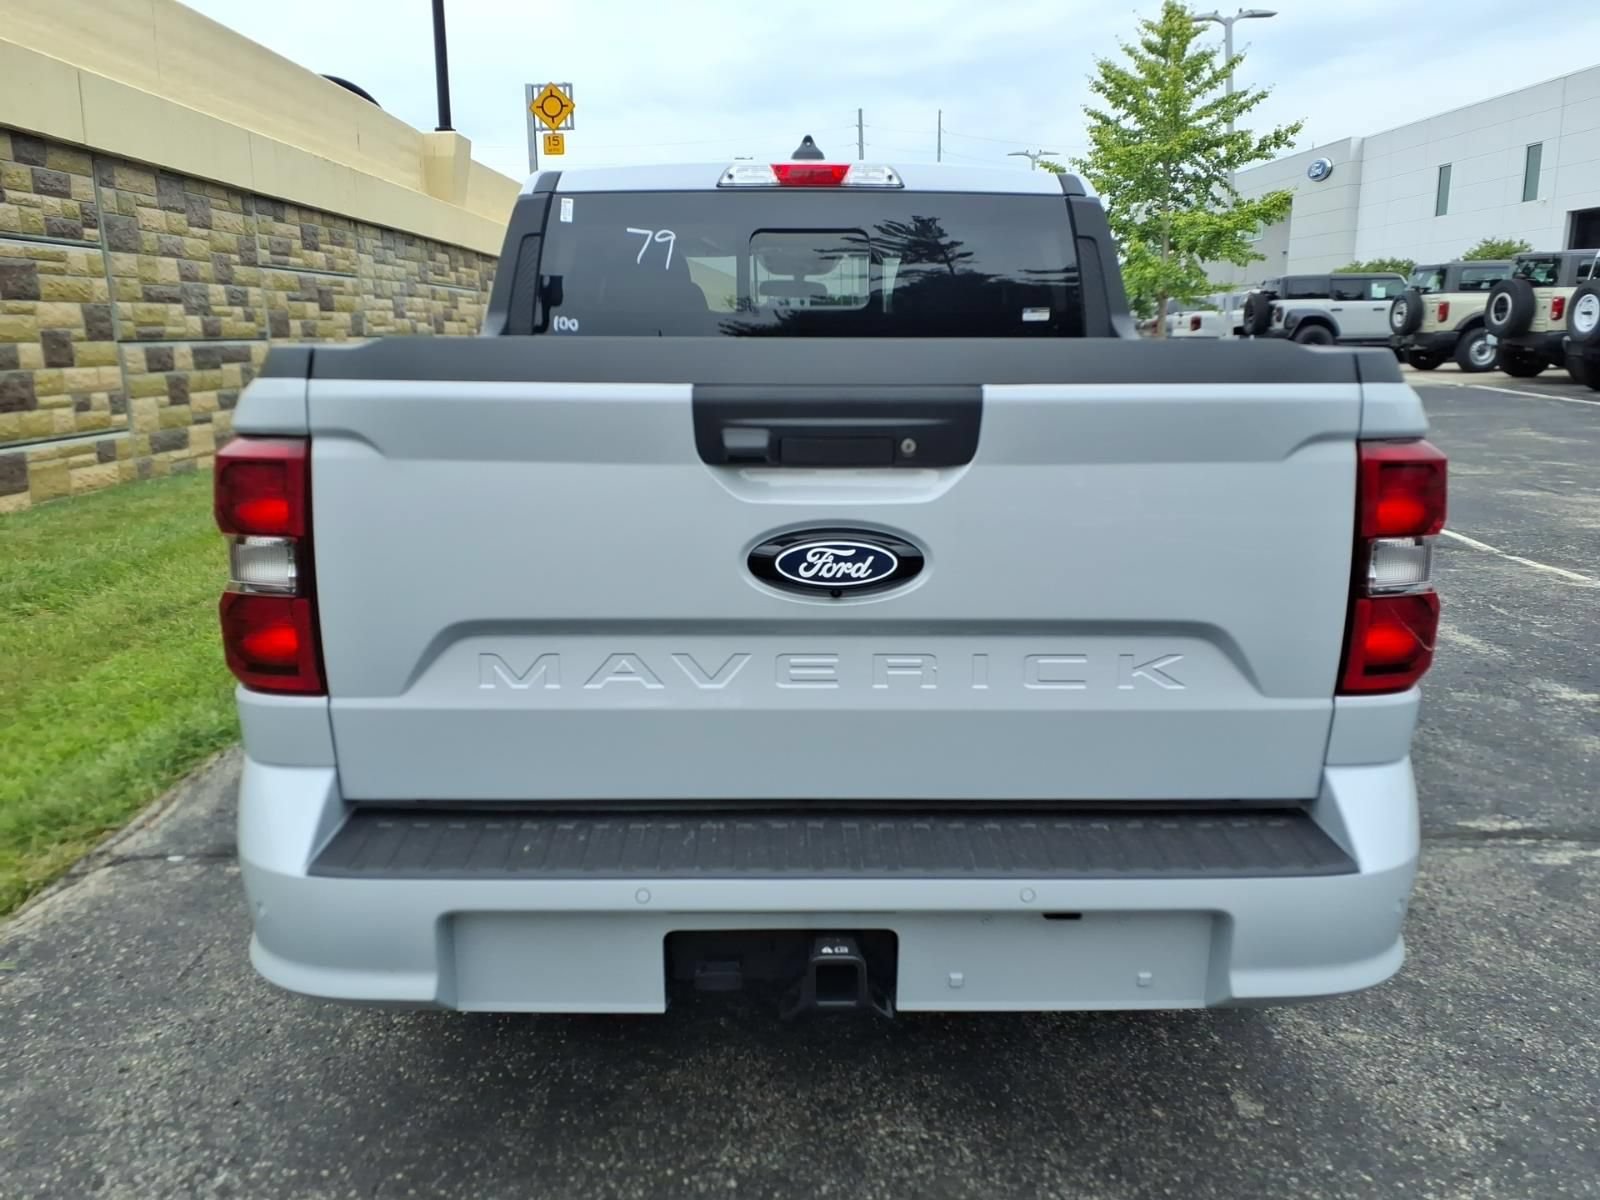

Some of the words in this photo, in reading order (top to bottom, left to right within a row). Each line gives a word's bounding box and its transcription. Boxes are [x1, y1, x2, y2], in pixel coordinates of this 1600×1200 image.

[548, 136, 560, 147] 15
[626, 227, 676, 270] 79
[553, 315, 579, 332] 100
[798, 547, 874, 578] Ford
[479, 652, 1186, 690] MAVERICK
